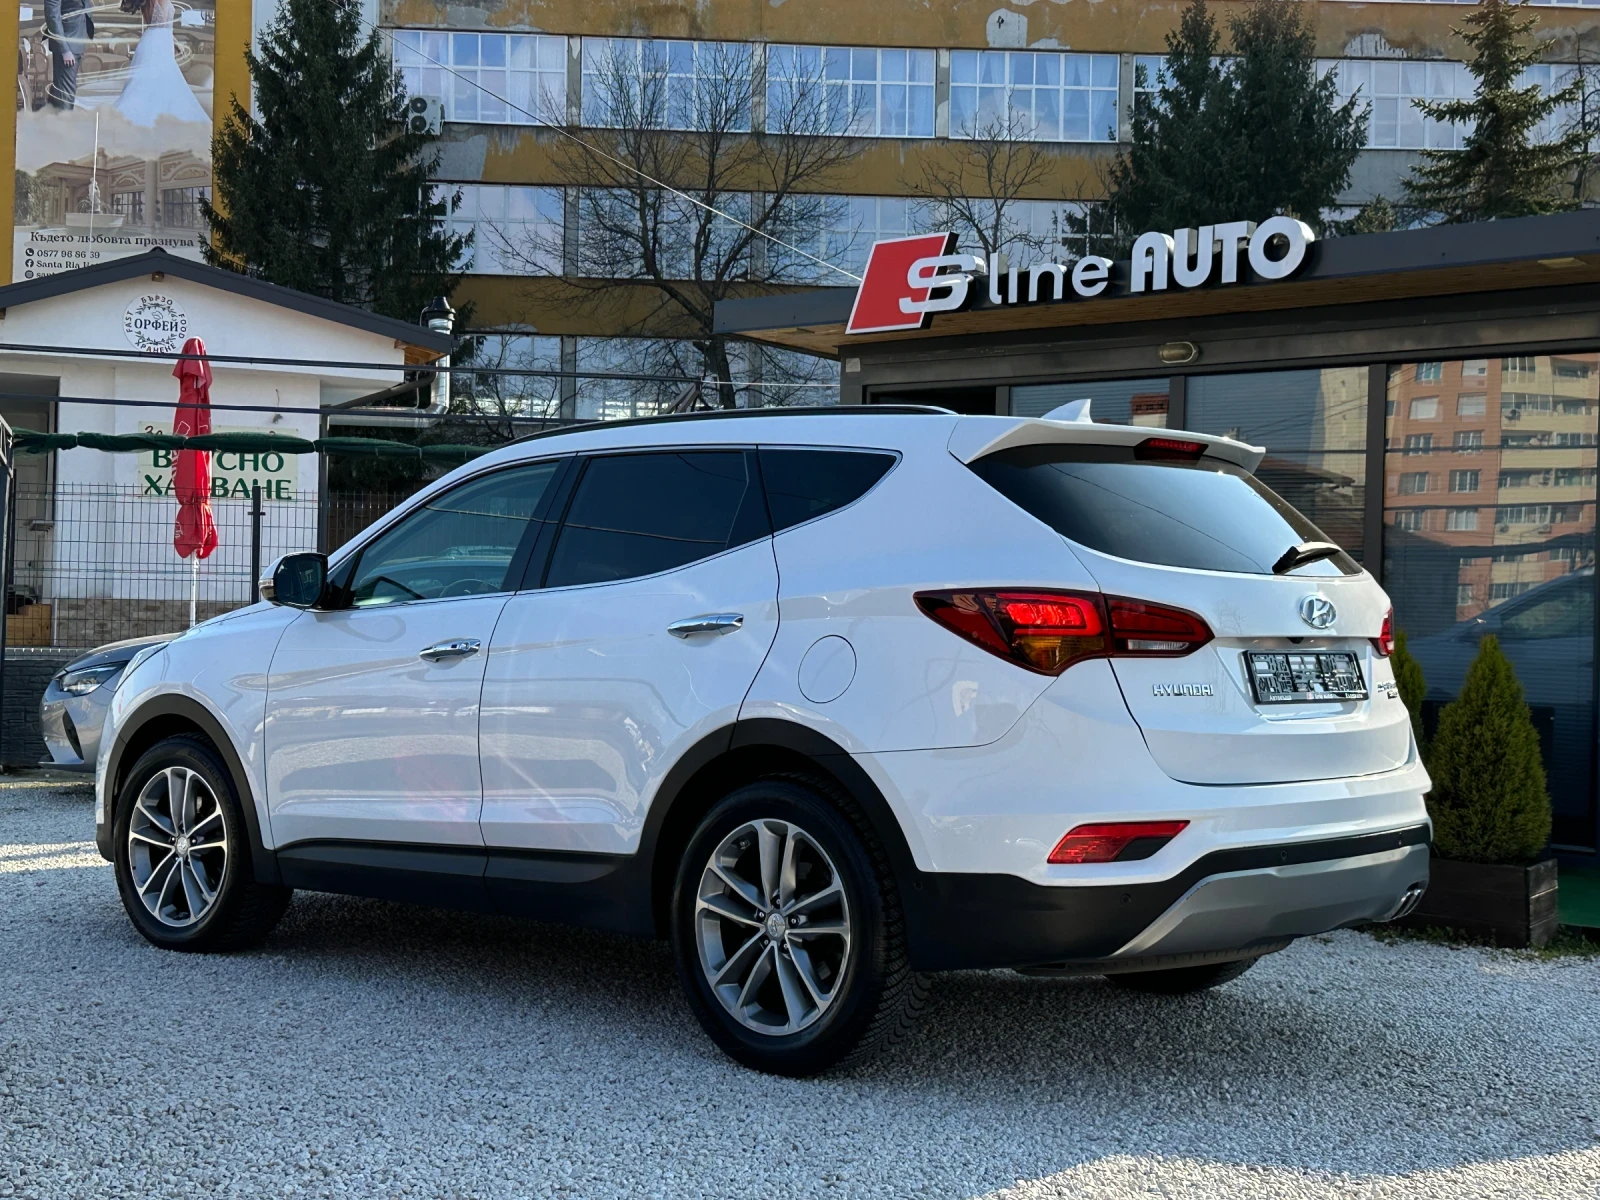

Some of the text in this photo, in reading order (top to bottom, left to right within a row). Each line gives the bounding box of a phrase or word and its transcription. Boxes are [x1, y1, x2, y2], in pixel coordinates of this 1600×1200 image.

[30, 231, 194, 248] Където любовта празнува
[36, 249, 100, 259] 0877 96 86 39
[36, 260, 63, 269] Santa
[65, 261, 80, 269] Ria
[898, 215, 1307, 314] S line AUTO
[141, 295, 173, 305] БЪРЗО
[125, 311, 133, 332] FAST
[134, 318, 179, 332] ОРФЕЙ
[178, 314, 186, 338] FOOD
[1152, 684, 1213, 696] HYUNDAI
